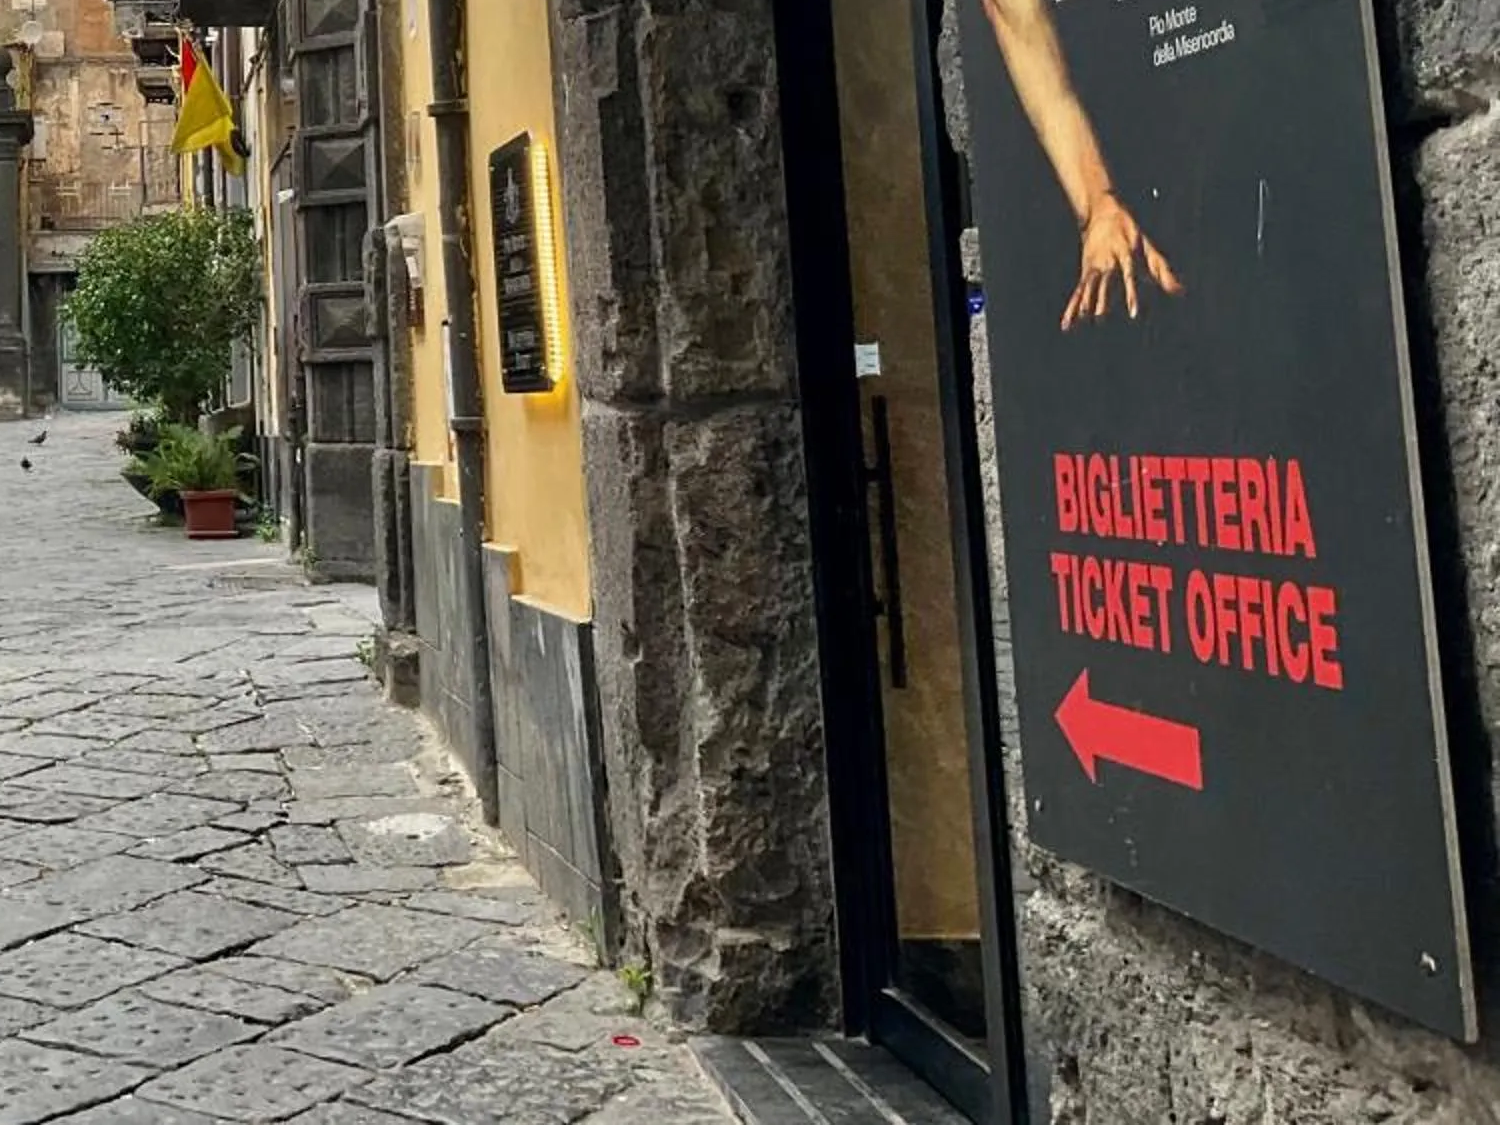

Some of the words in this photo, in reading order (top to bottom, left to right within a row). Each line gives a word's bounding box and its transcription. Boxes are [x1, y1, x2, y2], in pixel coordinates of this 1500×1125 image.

[1149, 14, 1165, 37] Pio
[1165, 6, 1197, 30] Monte
[1153, 42, 1176, 66] della
[1175, 19, 1235, 58] Misericordia
[1053, 453, 1316, 558] BIGLIETTERIA
[1050, 553, 1173, 653] TICKET
[1186, 569, 1343, 690] OFFICE
